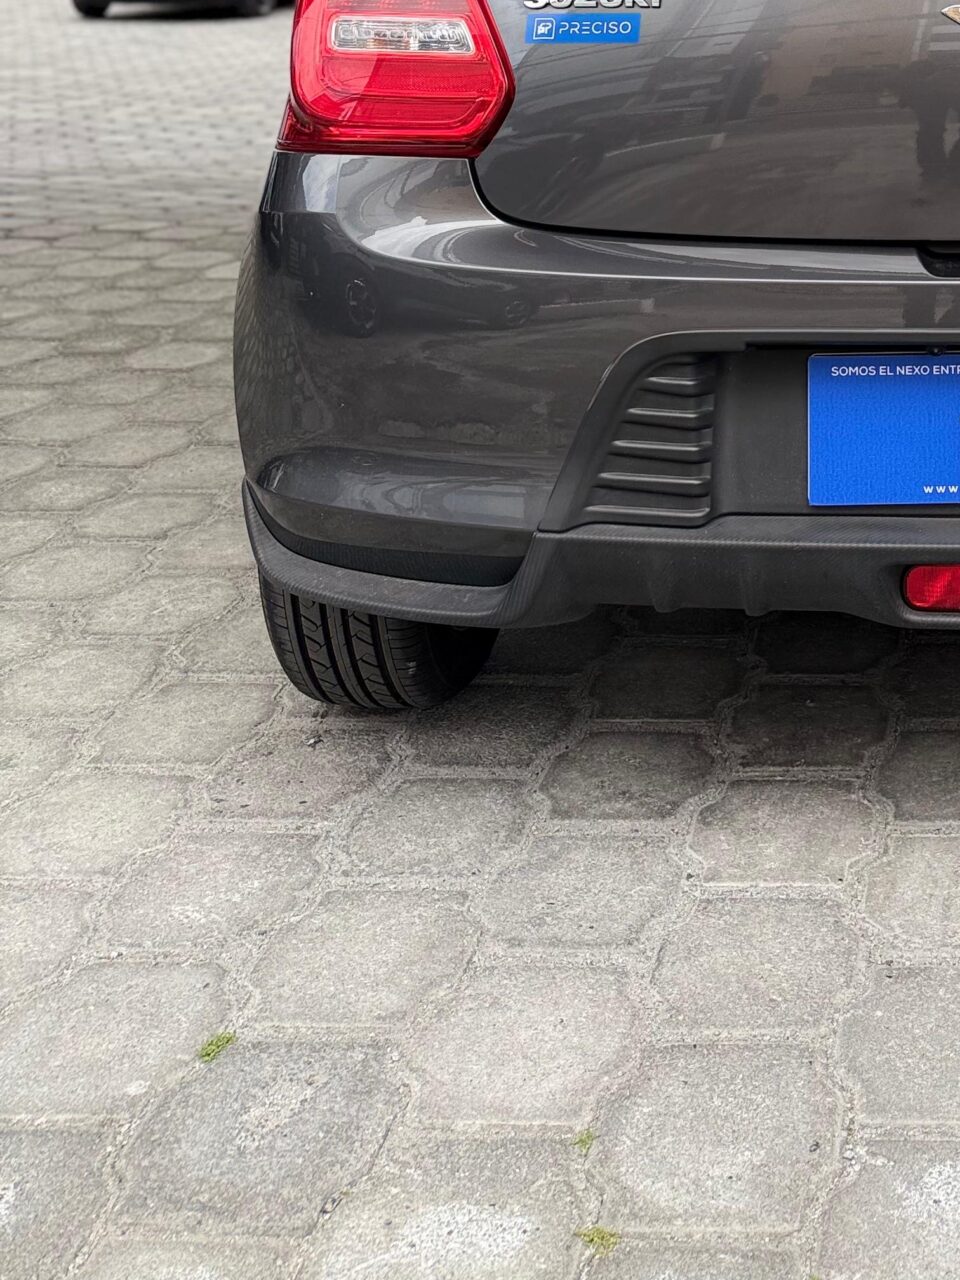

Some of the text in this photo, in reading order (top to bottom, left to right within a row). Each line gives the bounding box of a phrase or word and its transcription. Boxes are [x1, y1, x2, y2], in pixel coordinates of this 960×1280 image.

[558, 21, 632, 34] PRECISO
[831, 365, 876, 376] SOMOS
[878, 365, 894, 376] EL
[896, 365, 930, 376] NEXO
